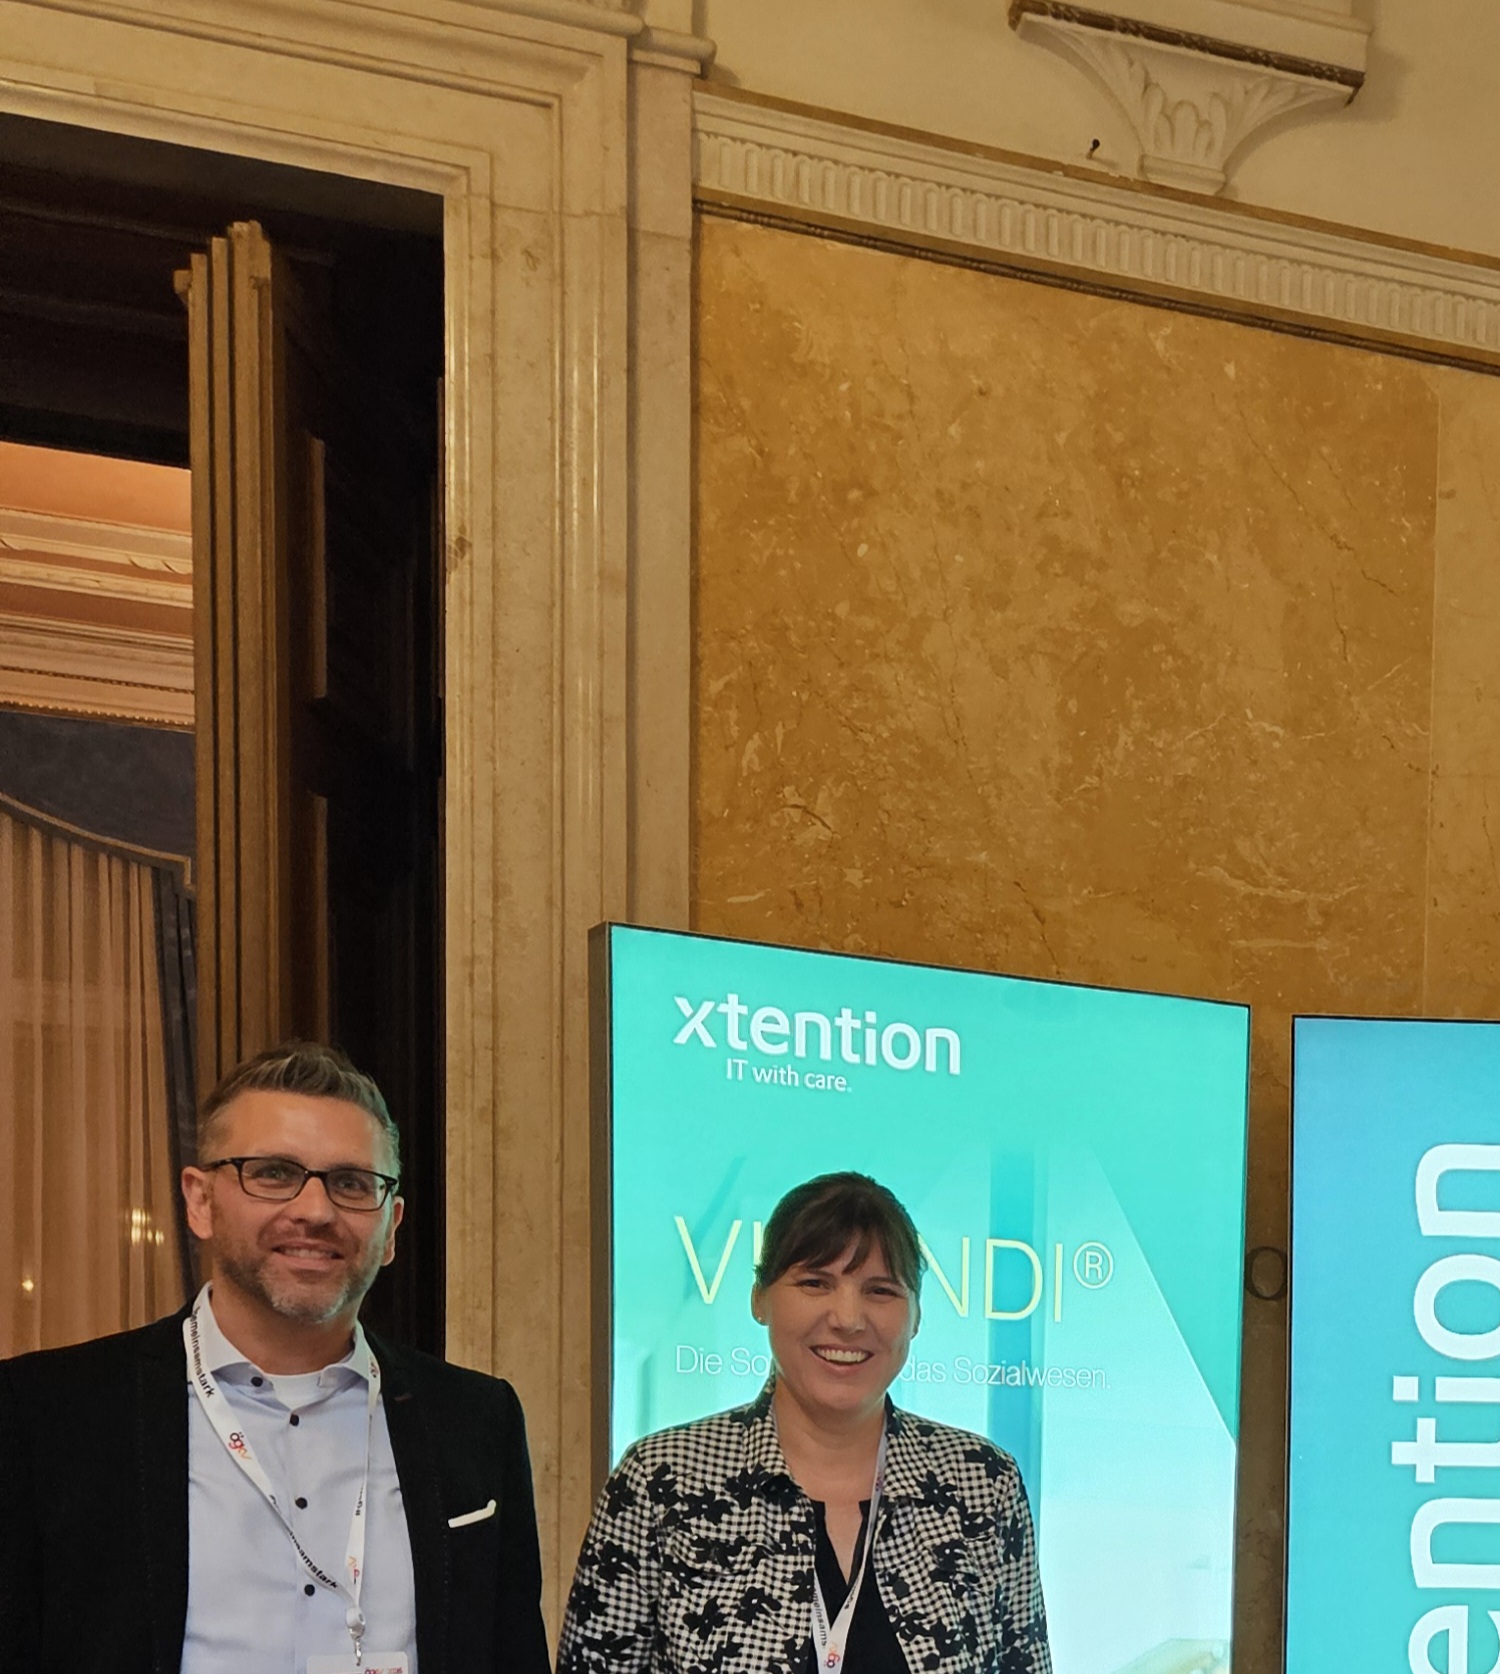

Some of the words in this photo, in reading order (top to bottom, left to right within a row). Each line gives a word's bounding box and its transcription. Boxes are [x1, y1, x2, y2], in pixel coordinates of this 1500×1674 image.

[673, 993, 960, 1075] xtention
[727, 1058, 748, 1081] IT
[752, 1064, 799, 1087] with
[803, 1072, 852, 1093] care.
[676, 1345, 722, 1375] Die
[900, 1357, 946, 1382] das
[954, 1357, 1111, 1389] Sozialwesen.
